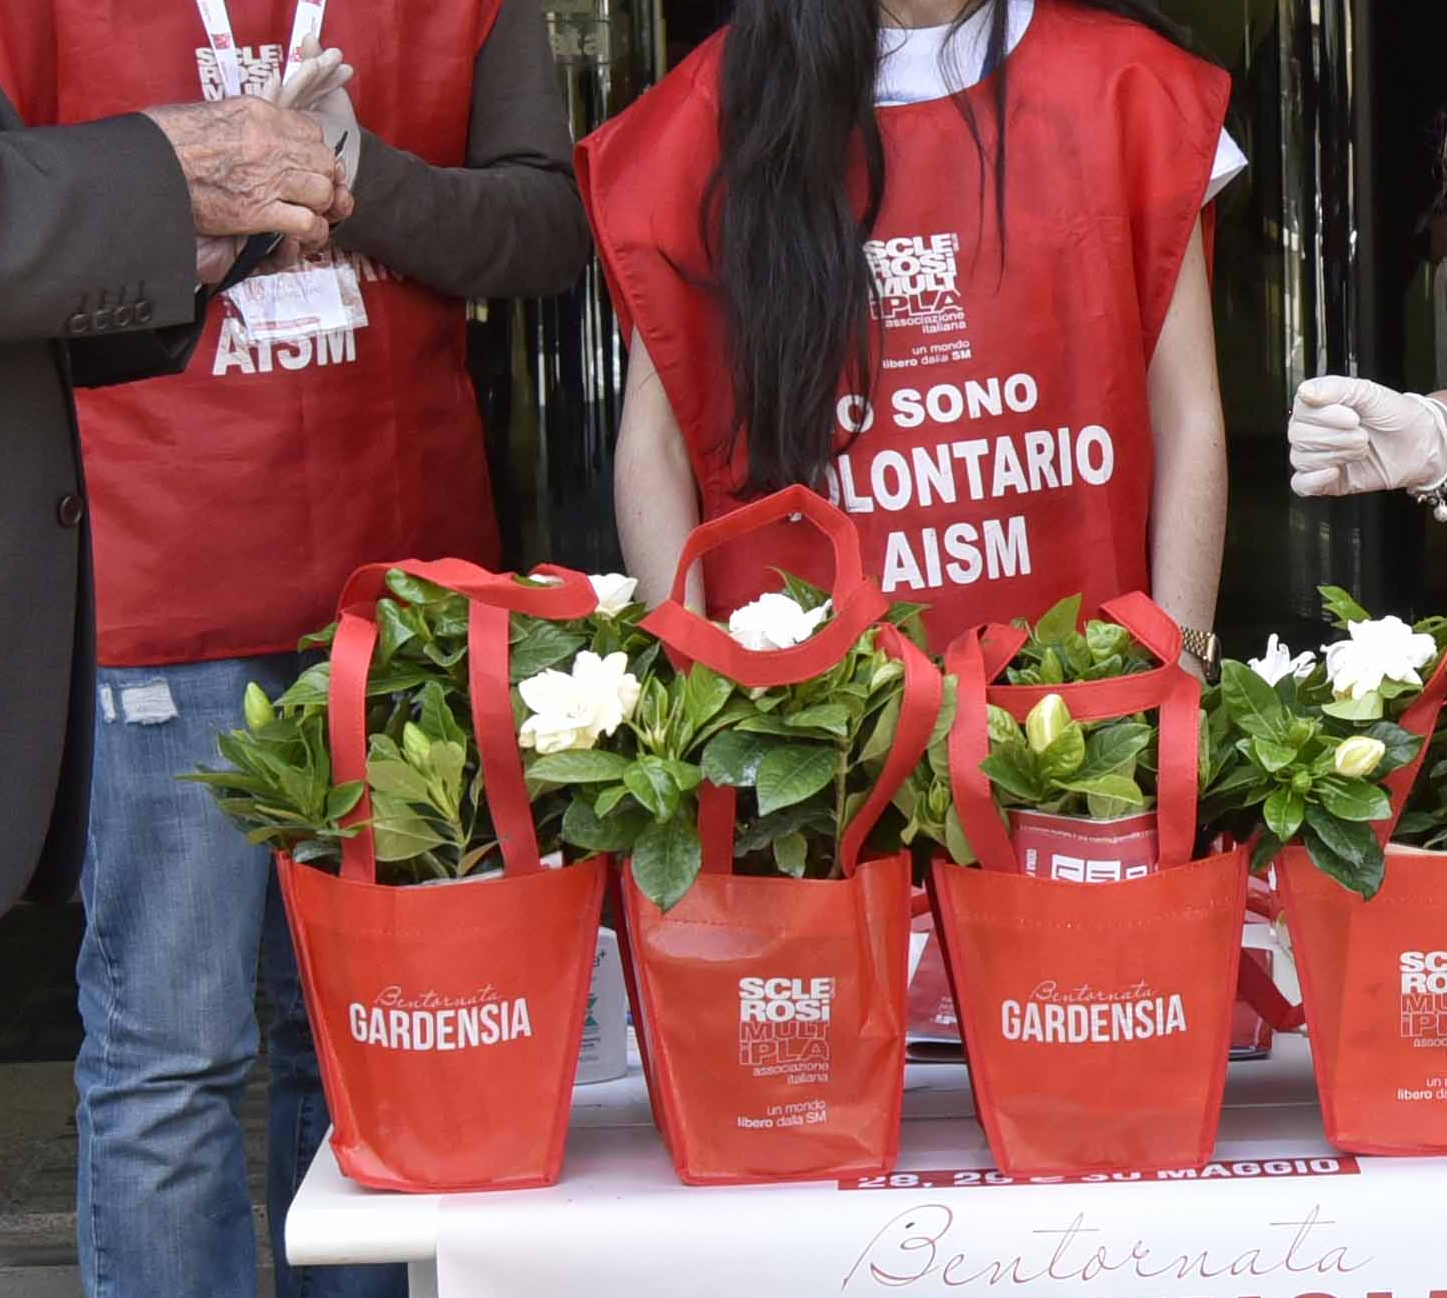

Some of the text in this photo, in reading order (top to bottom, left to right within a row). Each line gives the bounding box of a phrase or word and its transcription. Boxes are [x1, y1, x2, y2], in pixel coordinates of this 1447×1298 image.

[886, 312, 965, 328] associazione
[922, 321, 967, 334] italiana
[912, 339, 970, 356] un mondo
[883, 349, 972, 370] libero dalla SM
[836, 372, 1038, 433] O SONO
[881, 515, 1032, 593] AISM
[373, 983, 503, 1009] Bentornata
[739, 977, 831, 1000] SCLE
[1030, 979, 1156, 1003] Bentornata
[349, 997, 533, 1051] GARDENSIA
[1002, 994, 1187, 1044] GARDENSIA
[739, 1021, 830, 1041] MULT
[753, 1061, 829, 1077] associazione
[787, 1073, 828, 1085] italiana
[1426, 1077, 1441, 1088] un
[1398, 1089, 1433, 1100] libero
[767, 1100, 825, 1116] un mondo
[737, 1111, 827, 1128] libero dalla SM
[841, 1203, 1375, 1291] Bentornata
